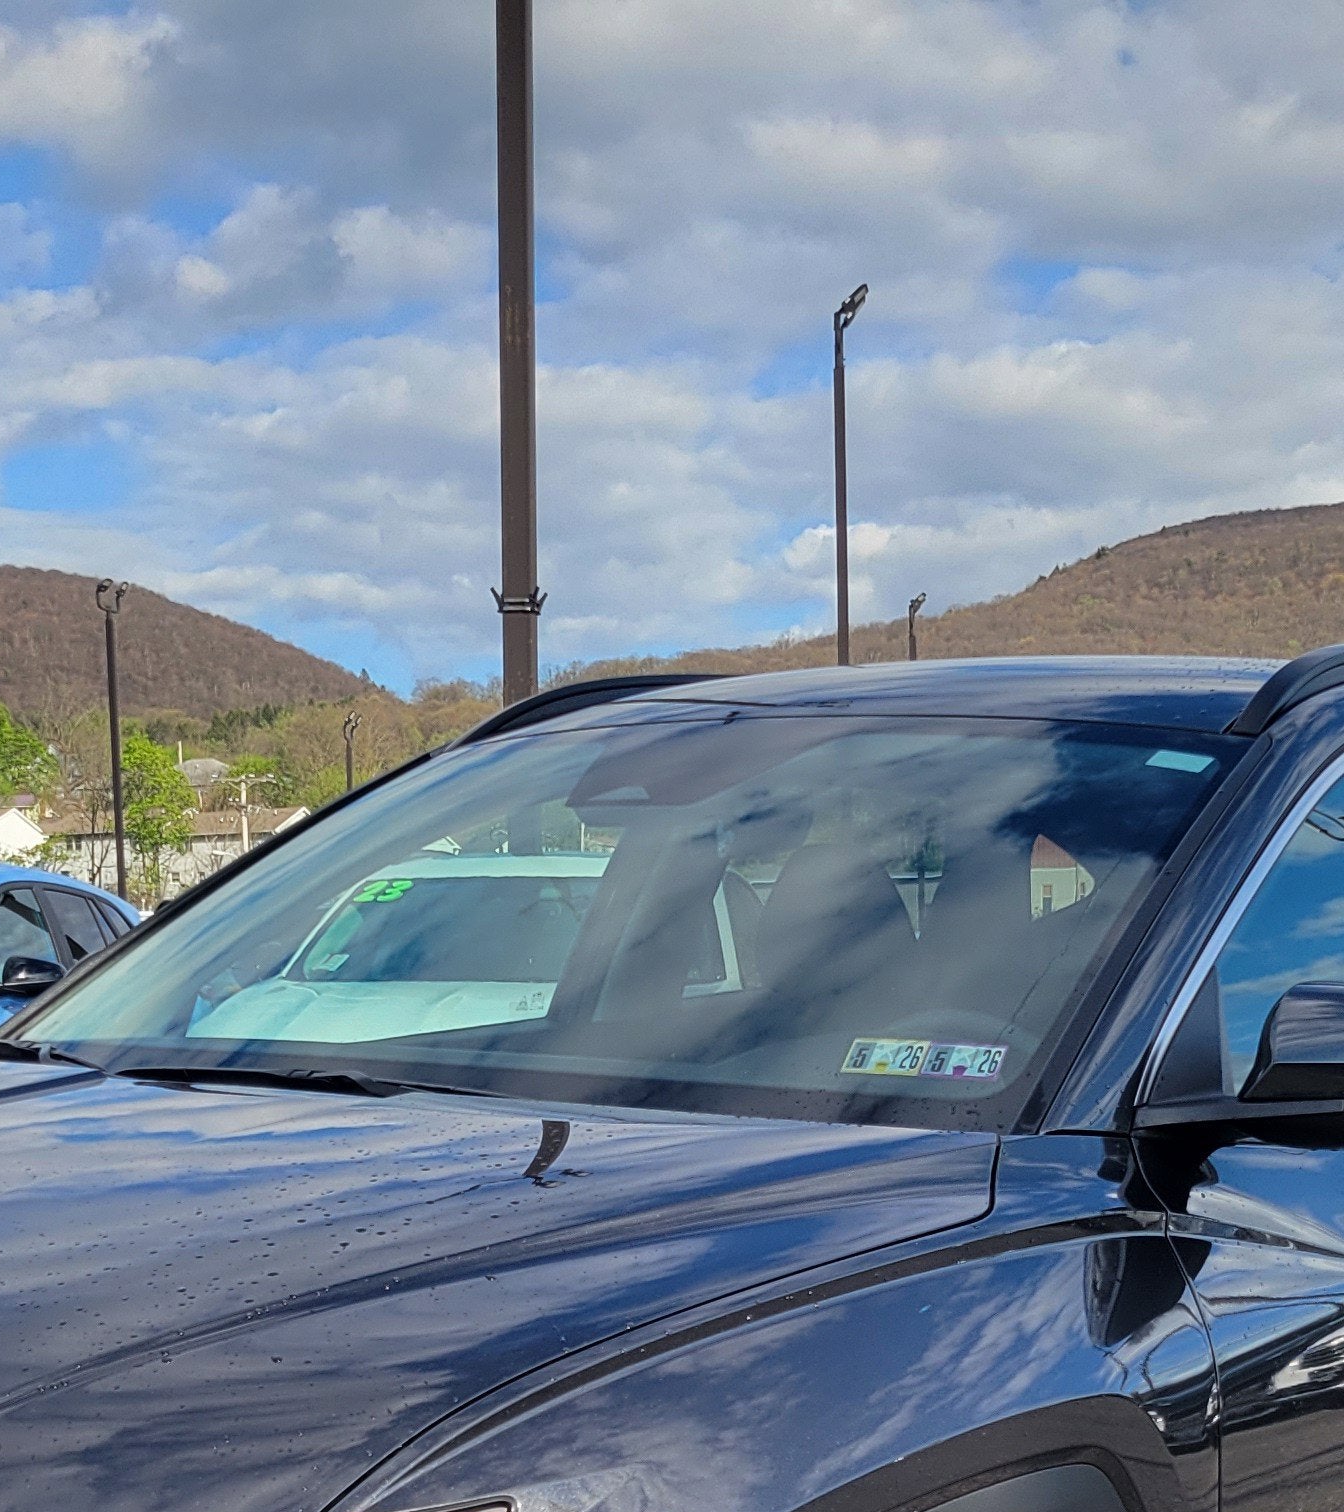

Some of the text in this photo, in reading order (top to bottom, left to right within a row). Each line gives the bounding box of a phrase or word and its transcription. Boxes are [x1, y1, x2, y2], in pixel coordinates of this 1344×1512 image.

[353, 880, 413, 903] 23
[854, 1045, 924, 1070] 5 26
[931, 1049, 1002, 1074] 5 26
